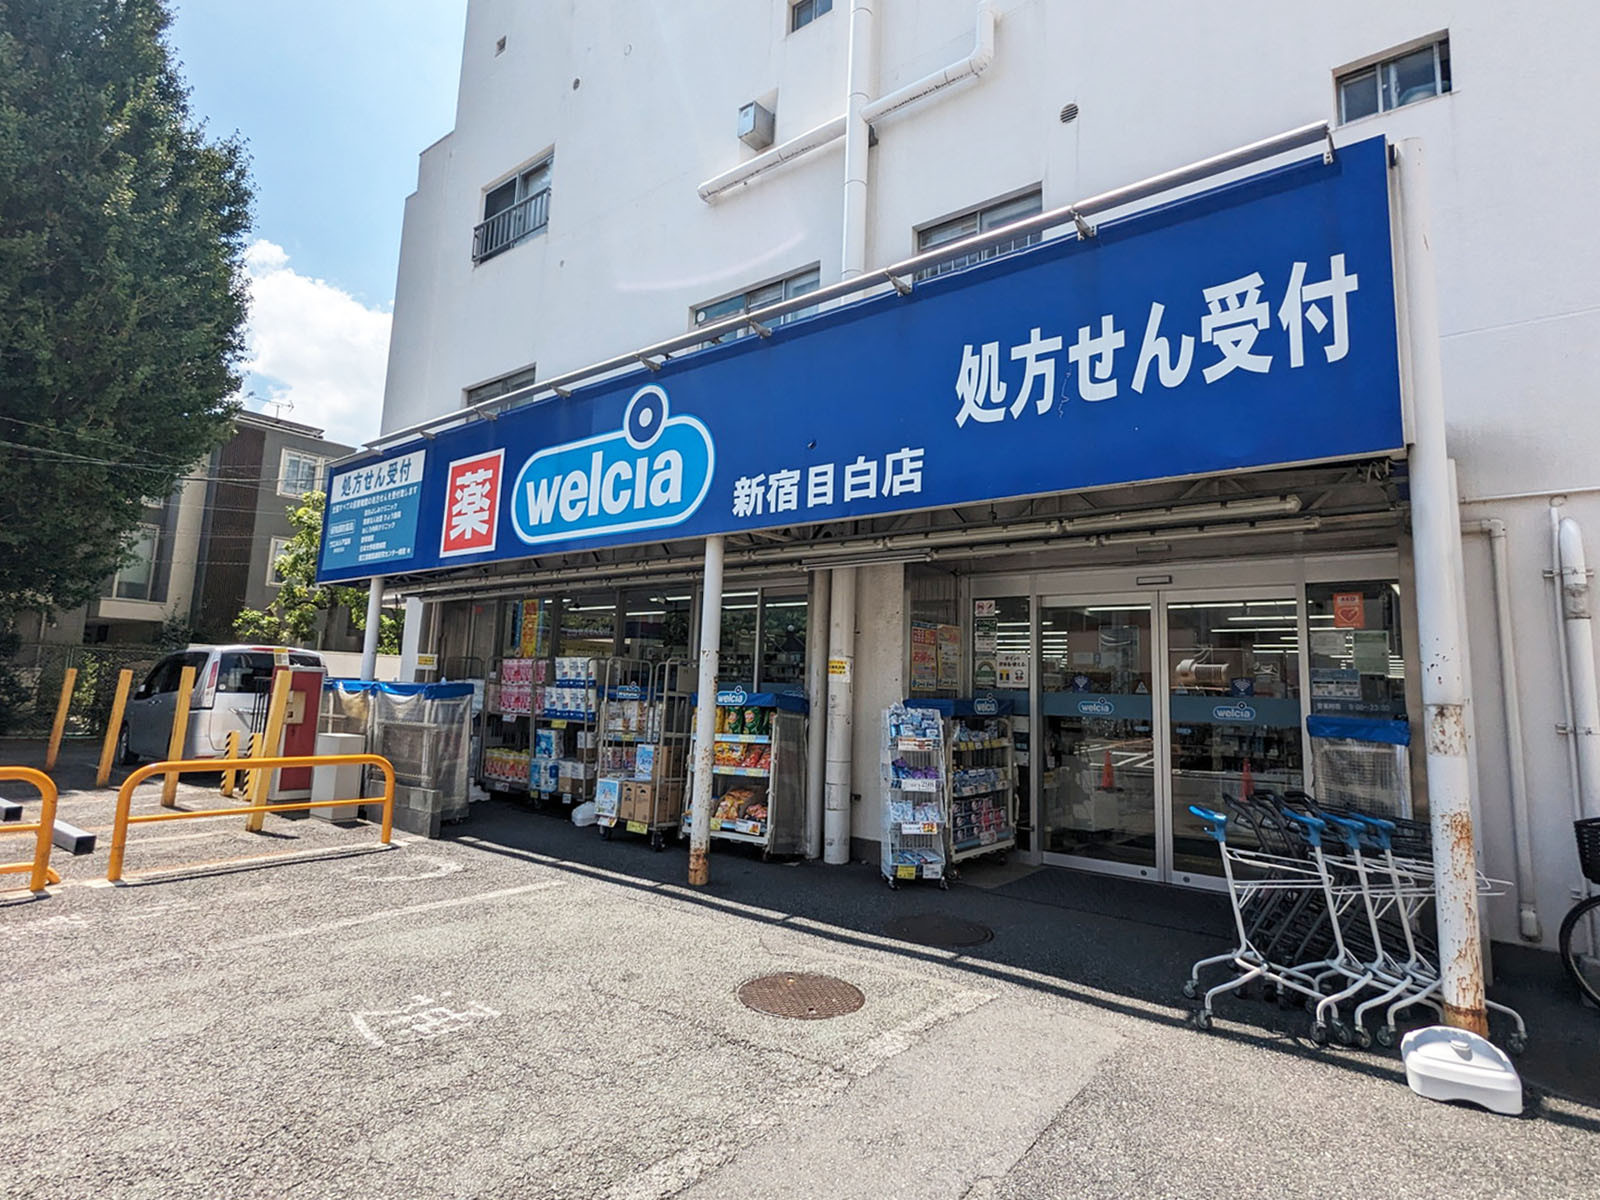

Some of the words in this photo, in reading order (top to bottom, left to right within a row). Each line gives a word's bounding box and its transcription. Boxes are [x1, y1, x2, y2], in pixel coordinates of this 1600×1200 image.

[955, 253, 1359, 428] 処方せん受付
[341, 458, 412, 496] 処方せん受付
[449, 468, 493, 541] 薬
[526, 449, 684, 527] welcia
[732, 447, 925, 518] 新宿目白店
[1081, 702, 1110, 713] welcia
[1216, 707, 1251, 719] welcia
